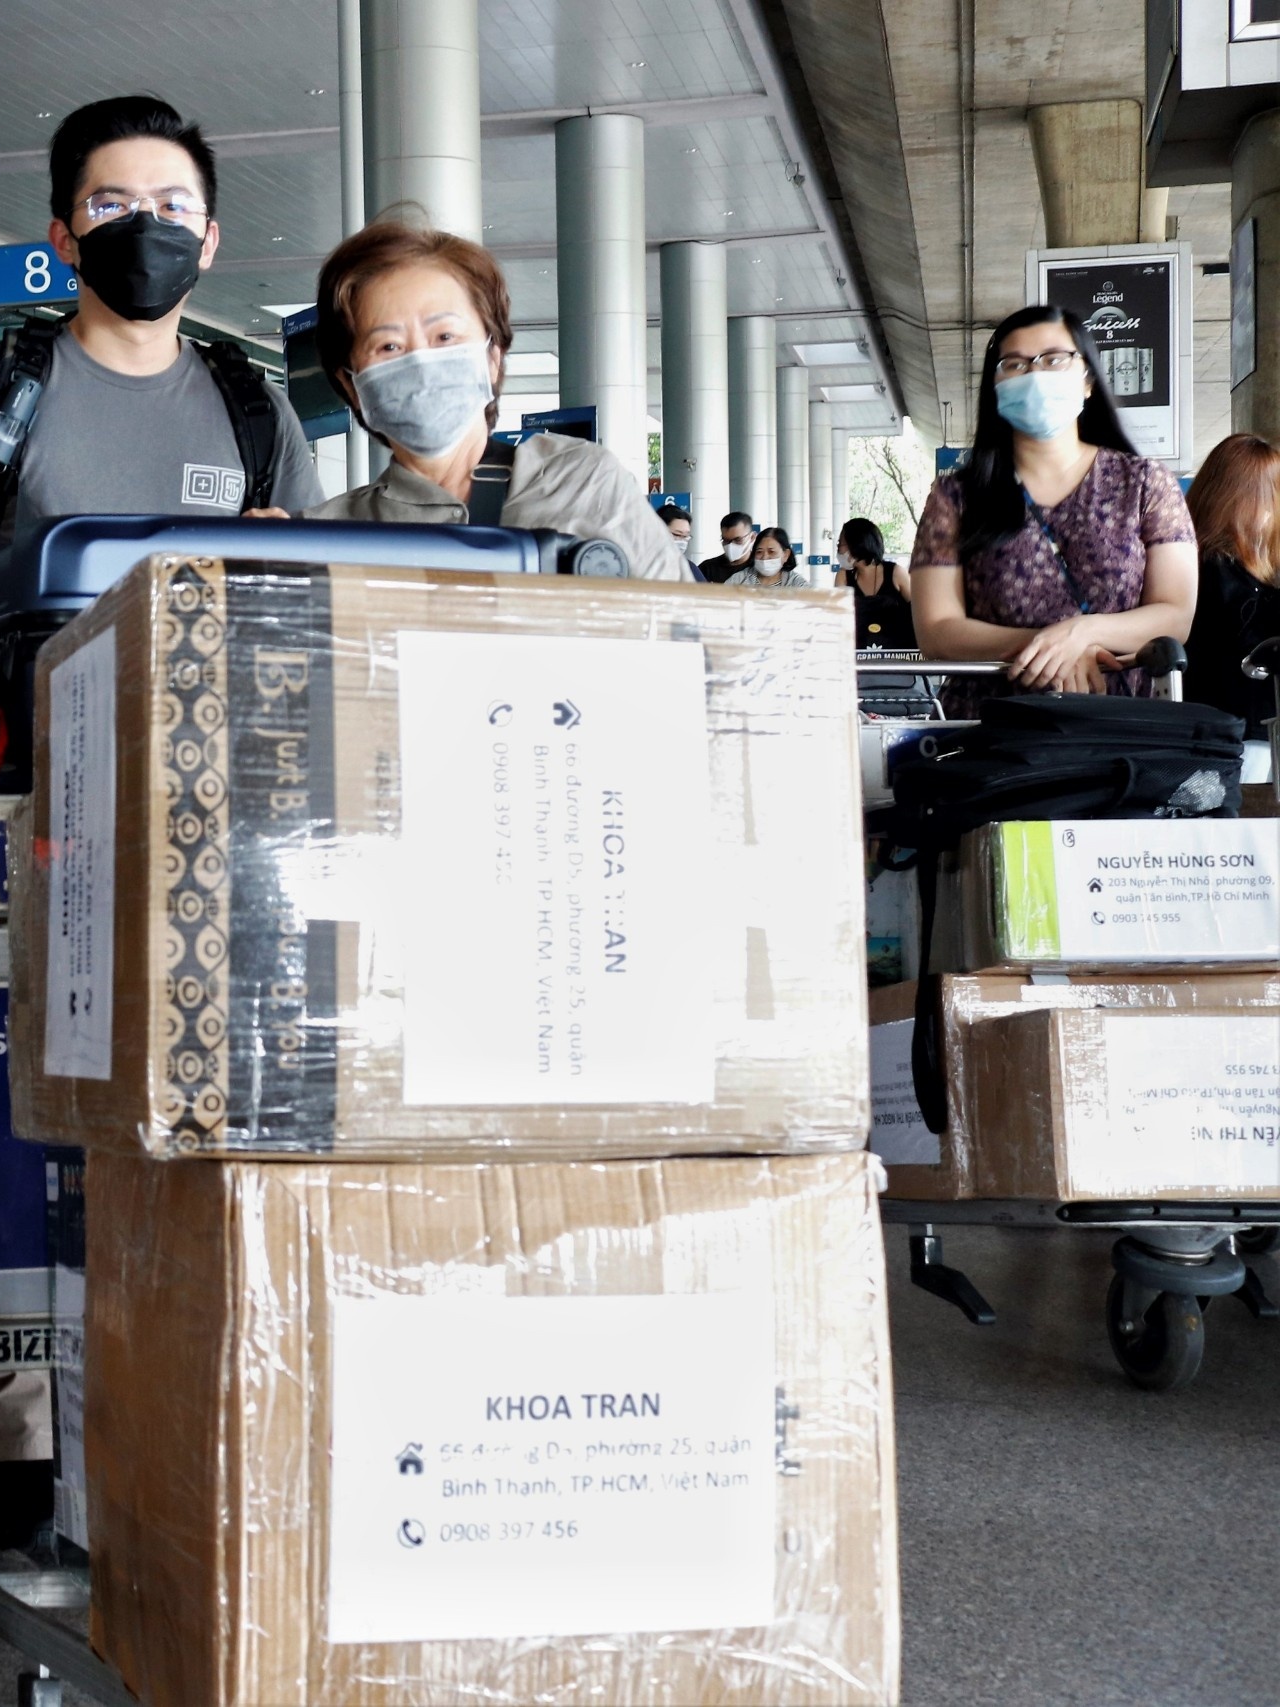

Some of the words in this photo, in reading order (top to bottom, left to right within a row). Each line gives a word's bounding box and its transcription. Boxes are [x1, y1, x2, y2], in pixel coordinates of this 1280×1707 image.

[24, 250, 51, 294] 8
[1092, 293, 1124, 305] Legend
[1106, 330, 1114, 340] 8
[883, 652, 926, 661] MANHATTA
[254, 727, 309, 786] Just
[492, 742, 510, 794] 0908
[494, 802, 511, 839] 397
[601, 789, 626, 880] KHOA
[1097, 851, 1163, 869] NGUYỄN
[1168, 853, 1215, 867] HÙNG
[1220, 855, 1255, 867] SƠN
[1108, 878, 1127, 887] 203
[1171, 877, 1186, 888] Thị
[1216, 876, 1256, 887] phường
[1258, 876, 1275, 885] 09,
[1116, 894, 1141, 903] quận
[1223, 892, 1240, 900] Chí
[1243, 892, 1270, 900] Minh
[1112, 914, 1138, 923] 0903
[1162, 913, 1181, 922] 955
[566, 893, 584, 976] phường
[537, 1024, 553, 1074] Nam
[1225, 1065, 1246, 1075] 955
[1249, 1065, 1269, 1074] 745
[1245, 1088, 1264, 1098] Tân
[485, 1396, 572, 1421] KHOA
[581, 1393, 660, 1419] TRAN
[442, 1479, 487, 1498] Bình
[494, 1477, 562, 1497] Thạnh,
[570, 1474, 654, 1494] TP.HCM,
[705, 1471, 750, 1489] Nam
[439, 1522, 490, 1543] 0908
[498, 1521, 534, 1541] 397
[541, 1520, 579, 1539] 456
